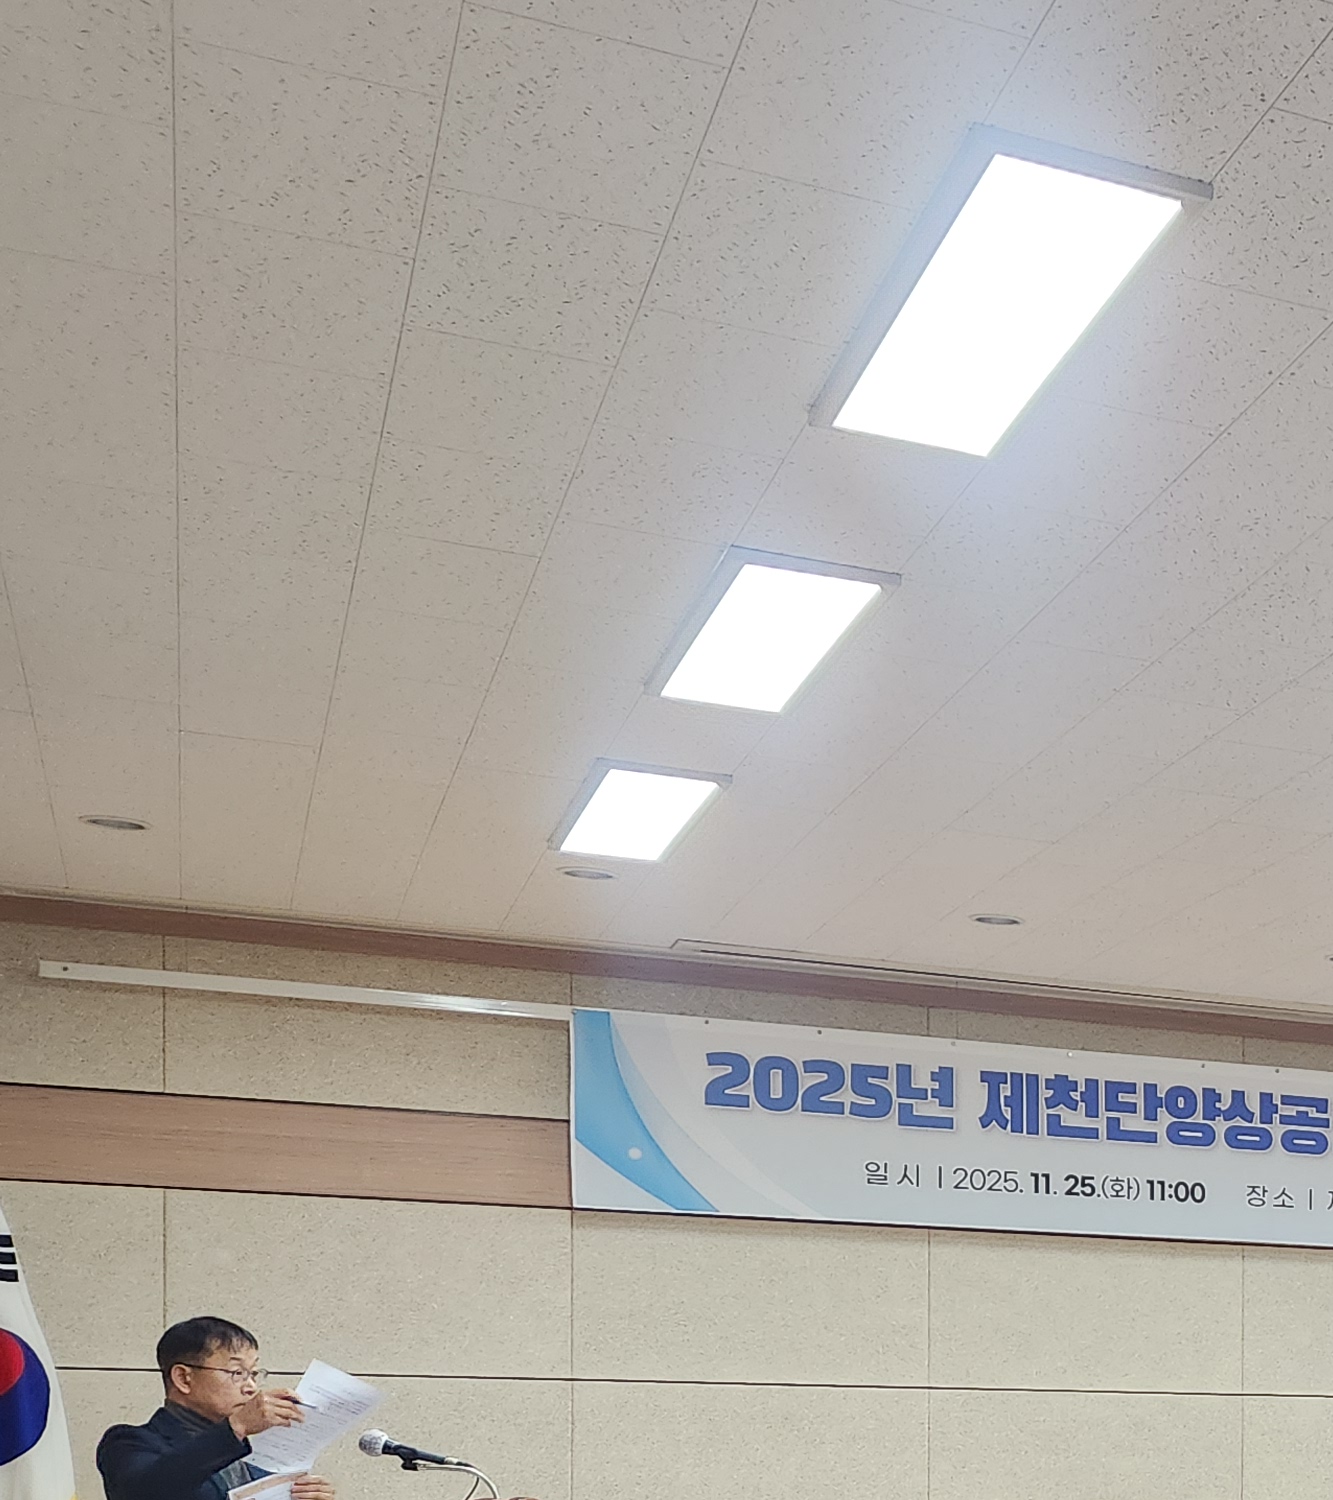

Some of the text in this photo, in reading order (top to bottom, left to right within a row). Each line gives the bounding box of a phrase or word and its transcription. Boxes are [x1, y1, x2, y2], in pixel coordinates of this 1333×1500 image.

[705, 1052, 955, 1130] 2025년
[952, 1167, 1025, 1194] 2025.
[1029, 1171, 1058, 1196] 11.
[1063, 1173, 1141, 1201] 25.(화)
[1145, 1179, 1206, 1204] 11:00
